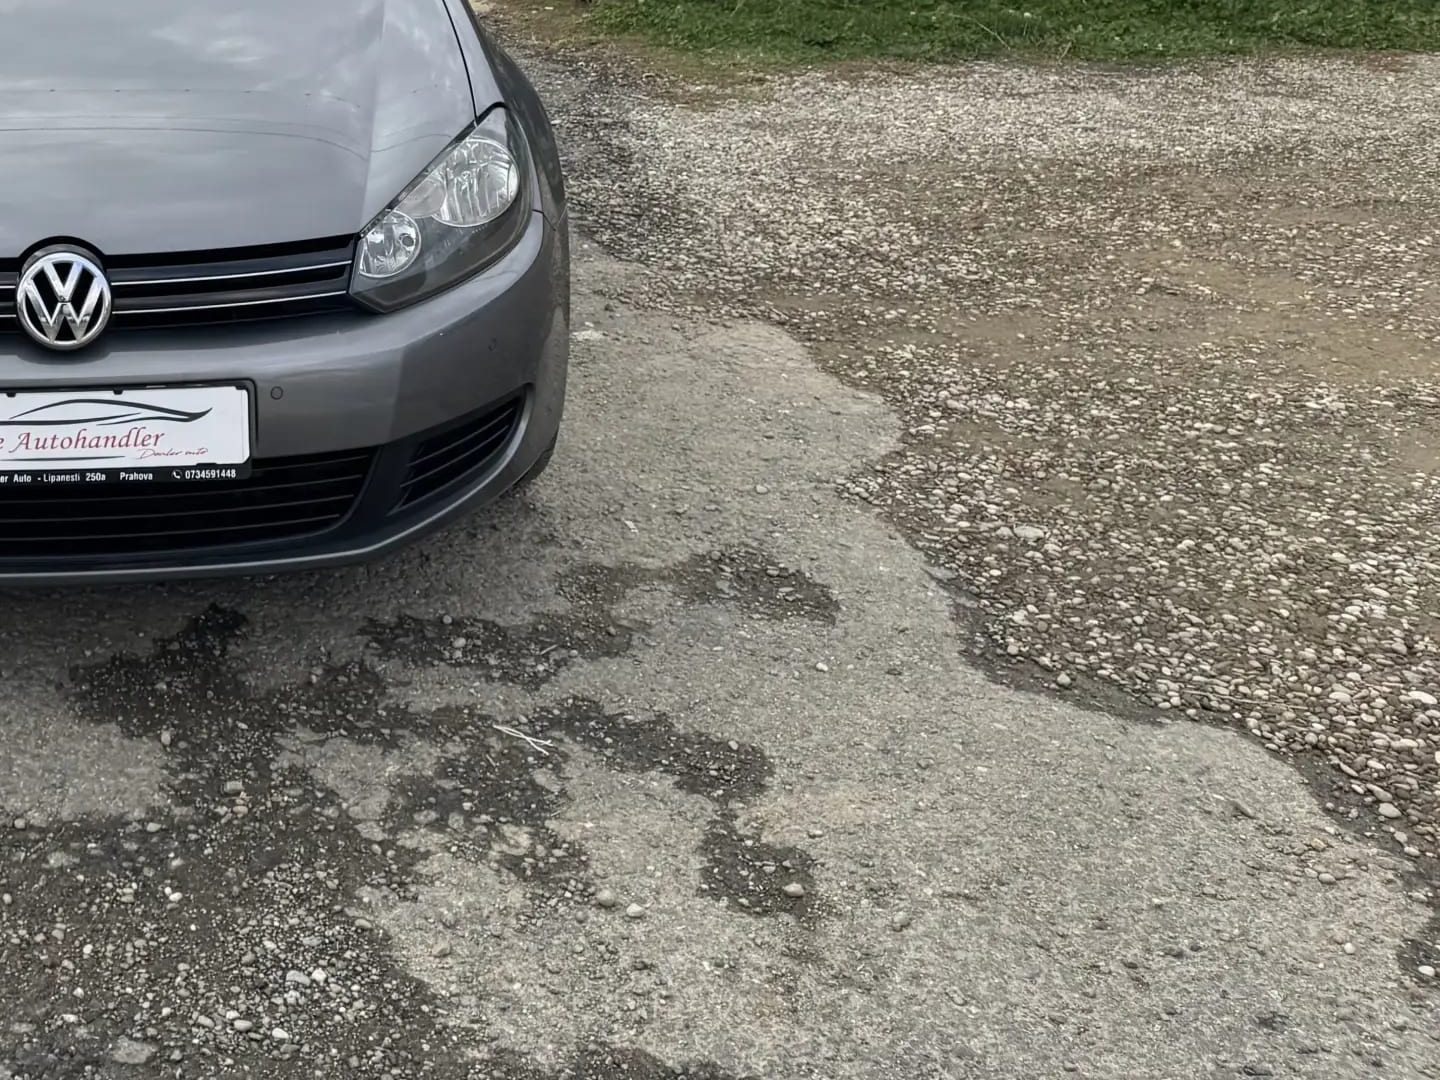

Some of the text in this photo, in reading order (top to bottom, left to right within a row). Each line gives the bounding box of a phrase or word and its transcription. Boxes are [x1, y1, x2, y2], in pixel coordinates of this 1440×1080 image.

[21, 257, 107, 345] VW
[9, 427, 165, 453] Autohandler
[13, 473, 32, 483] Auto
[43, 472, 80, 483] Lipanesti
[85, 472, 106, 482] 250a
[120, 471, 153, 481] Prahova
[185, 469, 236, 479] 0734591448
